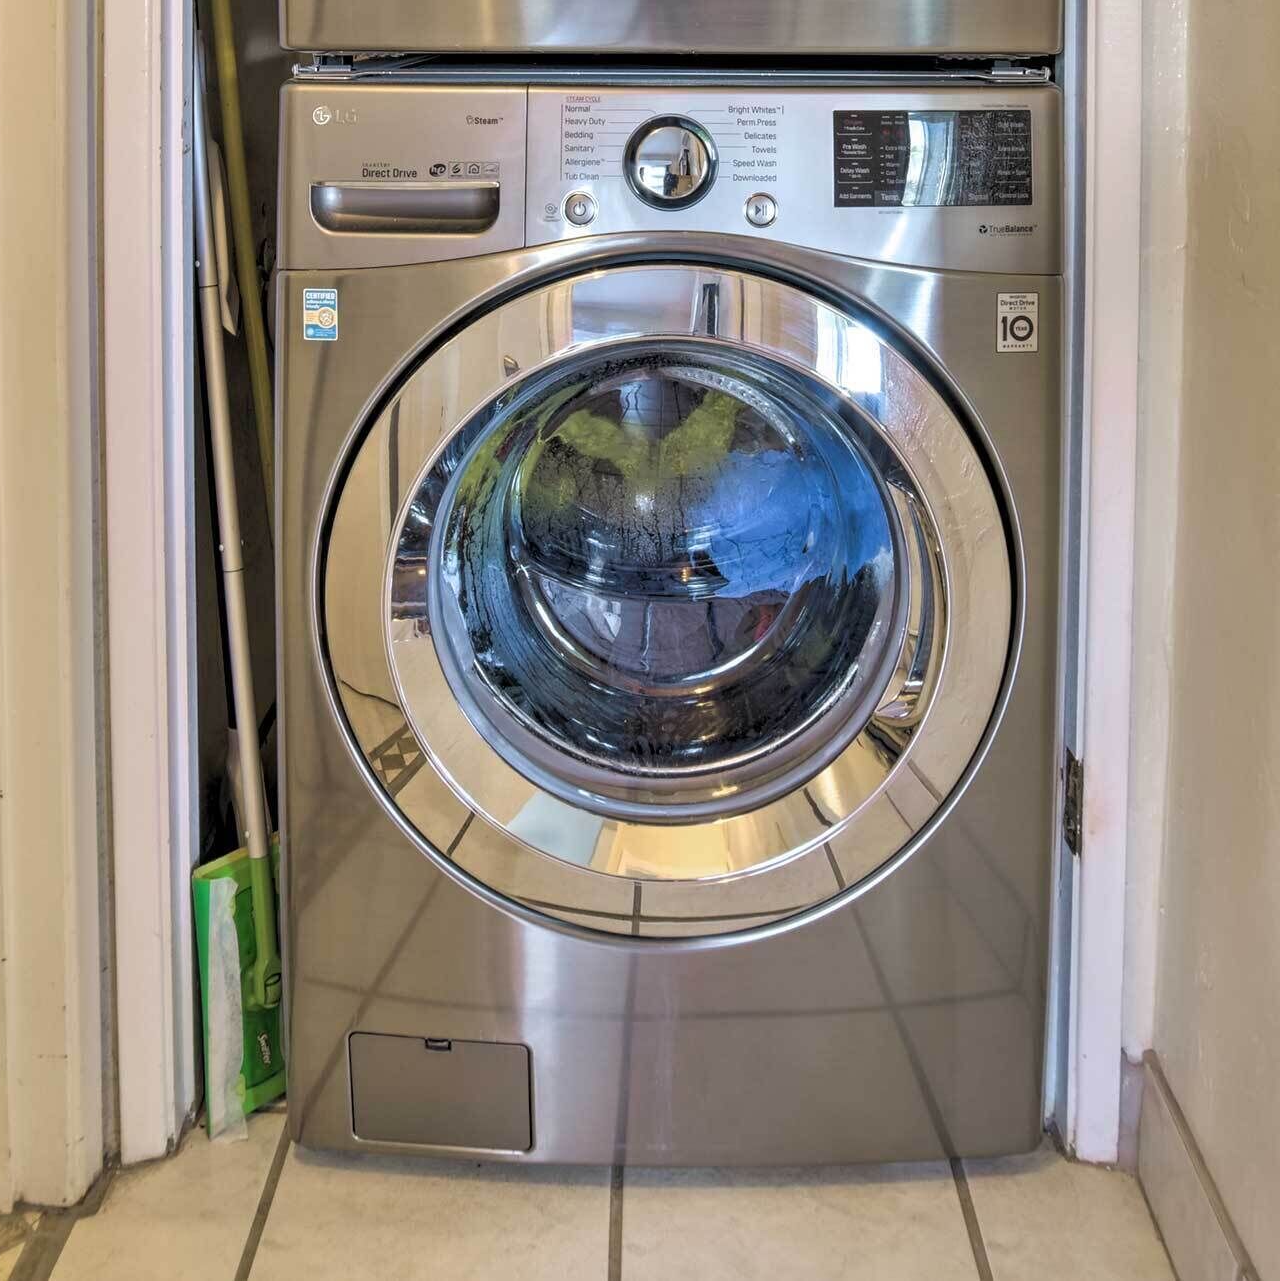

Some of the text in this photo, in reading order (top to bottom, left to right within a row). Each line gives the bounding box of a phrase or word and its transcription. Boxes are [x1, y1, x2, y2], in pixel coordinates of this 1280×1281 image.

[565, 105, 591, 113] Normal
[728, 106, 750, 115] Bright
[565, 118, 606, 126] Heavy Duty
[565, 131, 593, 139] Bedding
[744, 132, 777, 140] Delicates
[564, 145, 595, 153] Sanitary
[733, 159, 777, 168] Speed Wash
[362, 168, 417, 178] Direct Drive
[732, 173, 777, 182] Downloaded
[1001, 315, 1034, 342] 10
